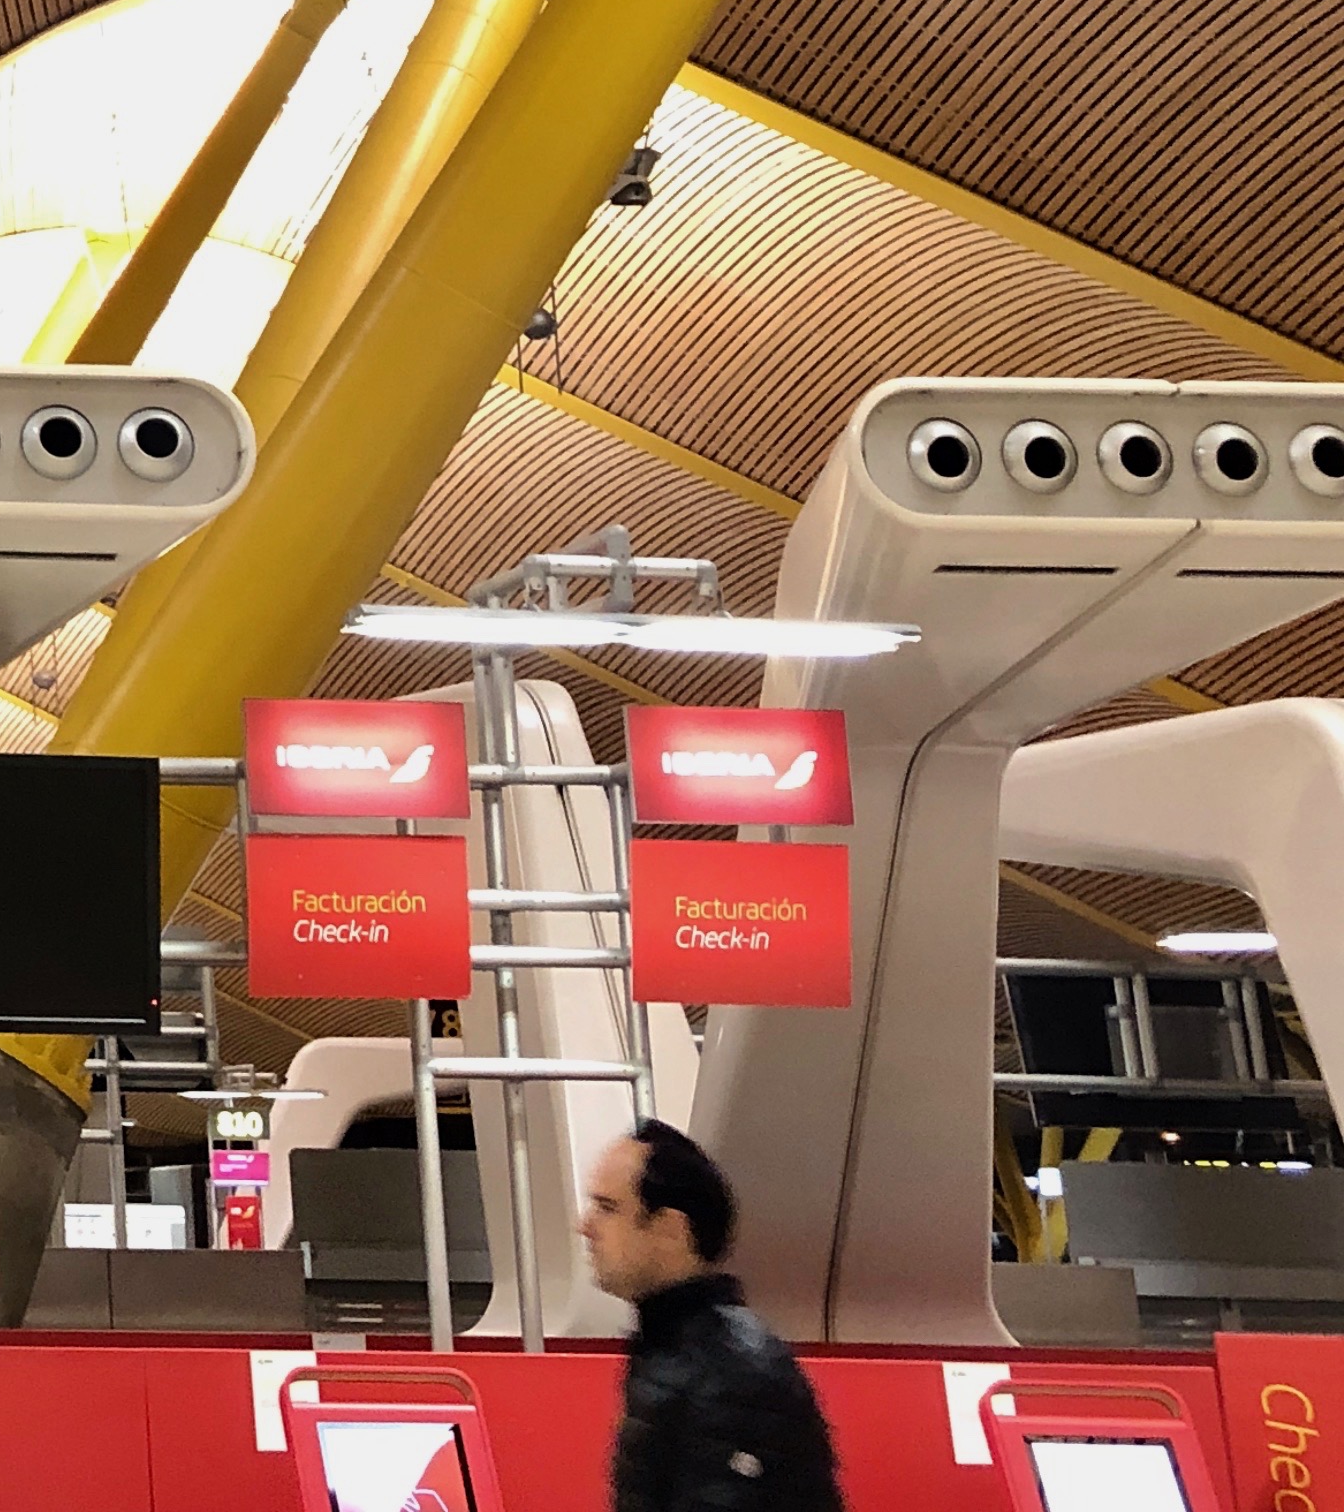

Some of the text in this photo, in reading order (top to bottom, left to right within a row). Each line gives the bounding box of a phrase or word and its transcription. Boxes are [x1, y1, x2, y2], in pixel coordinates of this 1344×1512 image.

[291, 889, 427, 914] Facturación
[674, 895, 808, 922] Facturación
[293, 919, 390, 944] Check-in
[674, 925, 770, 951] Check-in
